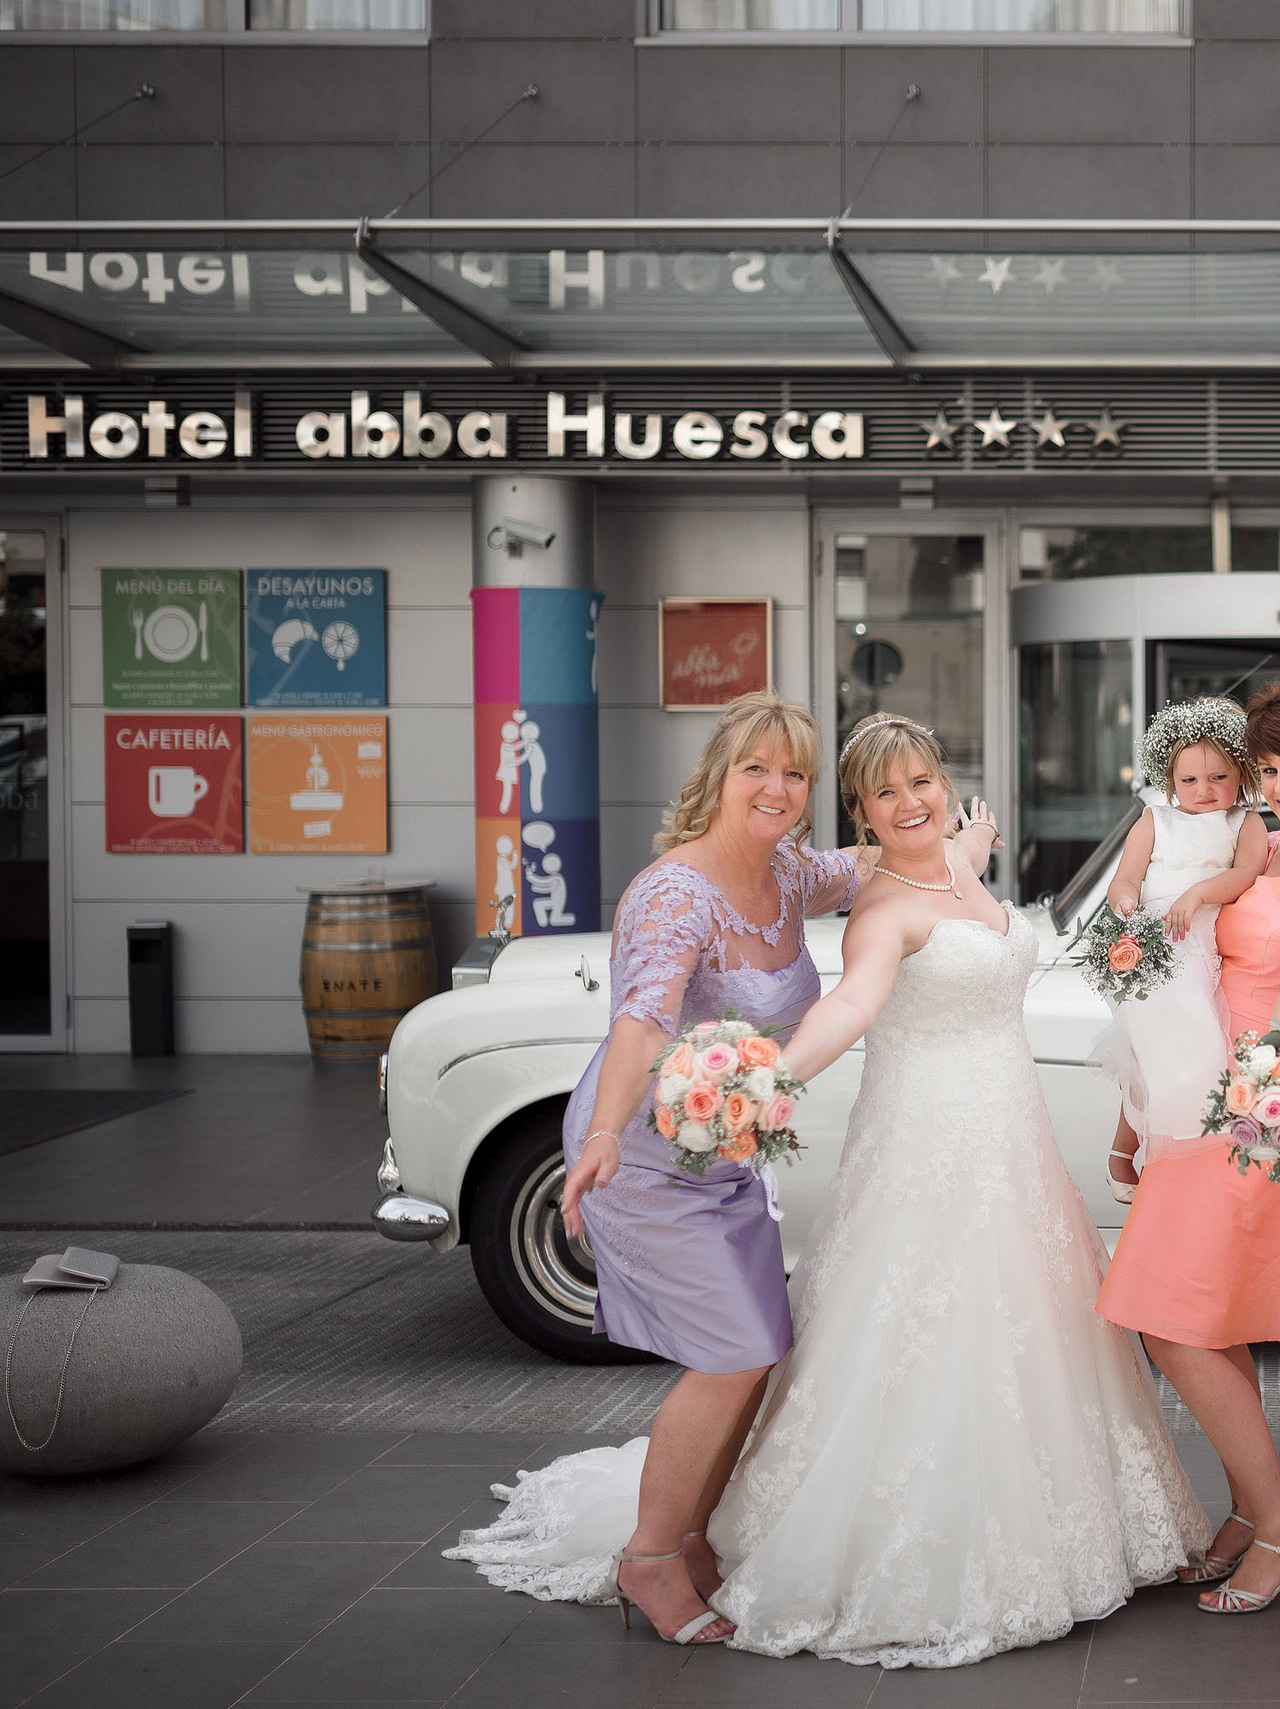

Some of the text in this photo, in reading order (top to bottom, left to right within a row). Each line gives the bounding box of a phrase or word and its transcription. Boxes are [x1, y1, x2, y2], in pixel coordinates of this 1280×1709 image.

[28, 389, 864, 460] Hotel abba Huesca
[167, 578, 194, 595] DEL
[198, 577, 226, 595] DÍA
[257, 576, 374, 596] DESAYUNOS
[285, 598, 346, 609] A LA CARTA
[116, 724, 231, 750] CAFETERÍA
[323, 979, 382, 993] ENATE
